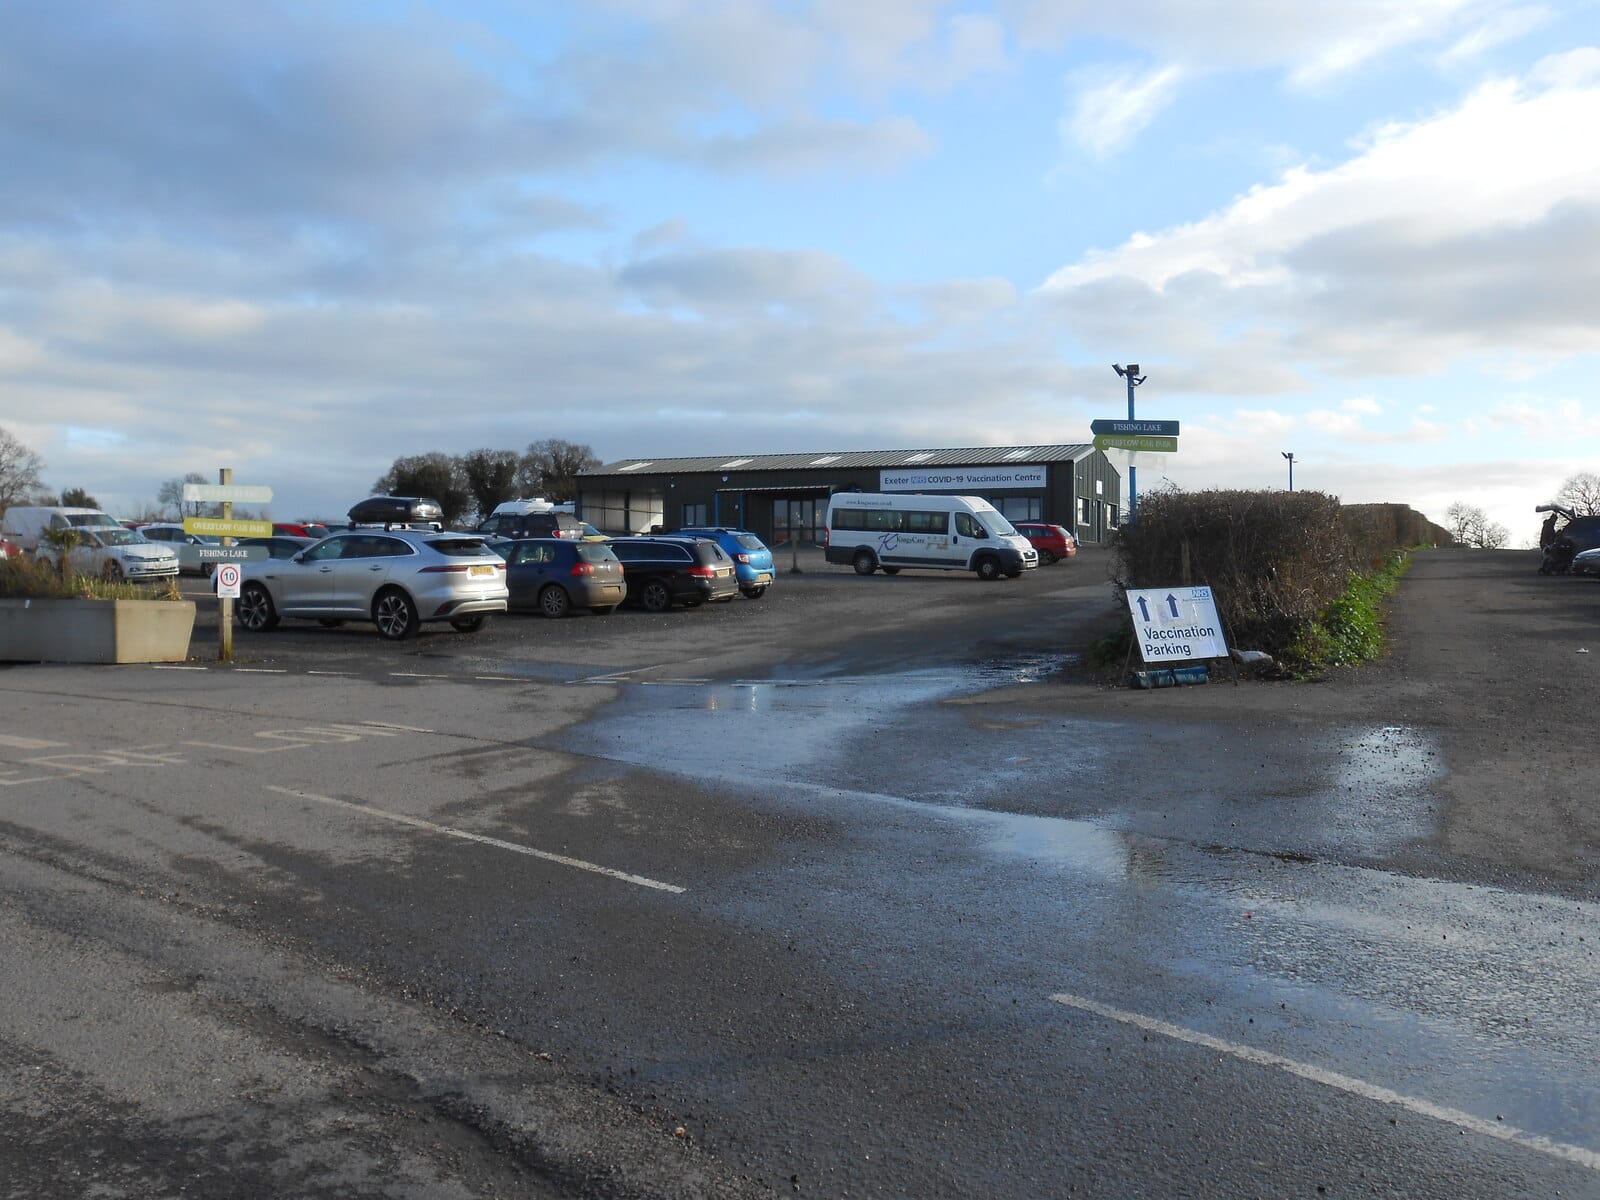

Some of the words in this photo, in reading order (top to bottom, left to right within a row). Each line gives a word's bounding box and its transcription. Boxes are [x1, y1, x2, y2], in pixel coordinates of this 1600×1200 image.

[1113, 423, 1141, 431] FISHING
[884, 477, 910, 485] Exeter
[927, 475, 964, 484] COVID-19
[966, 474, 1012, 483] Vaccination
[1014, 474, 1042, 482] Centre
[193, 522, 231, 531] OVERFLOW
[199, 549, 228, 558] FISHING
[229, 550, 248, 558] LAKE
[224, 572, 235, 581] 10
[1193, 589, 1209, 597] NHS
[1144, 626, 1215, 640] Vaccination
[1145, 643, 1192, 656] Parking
